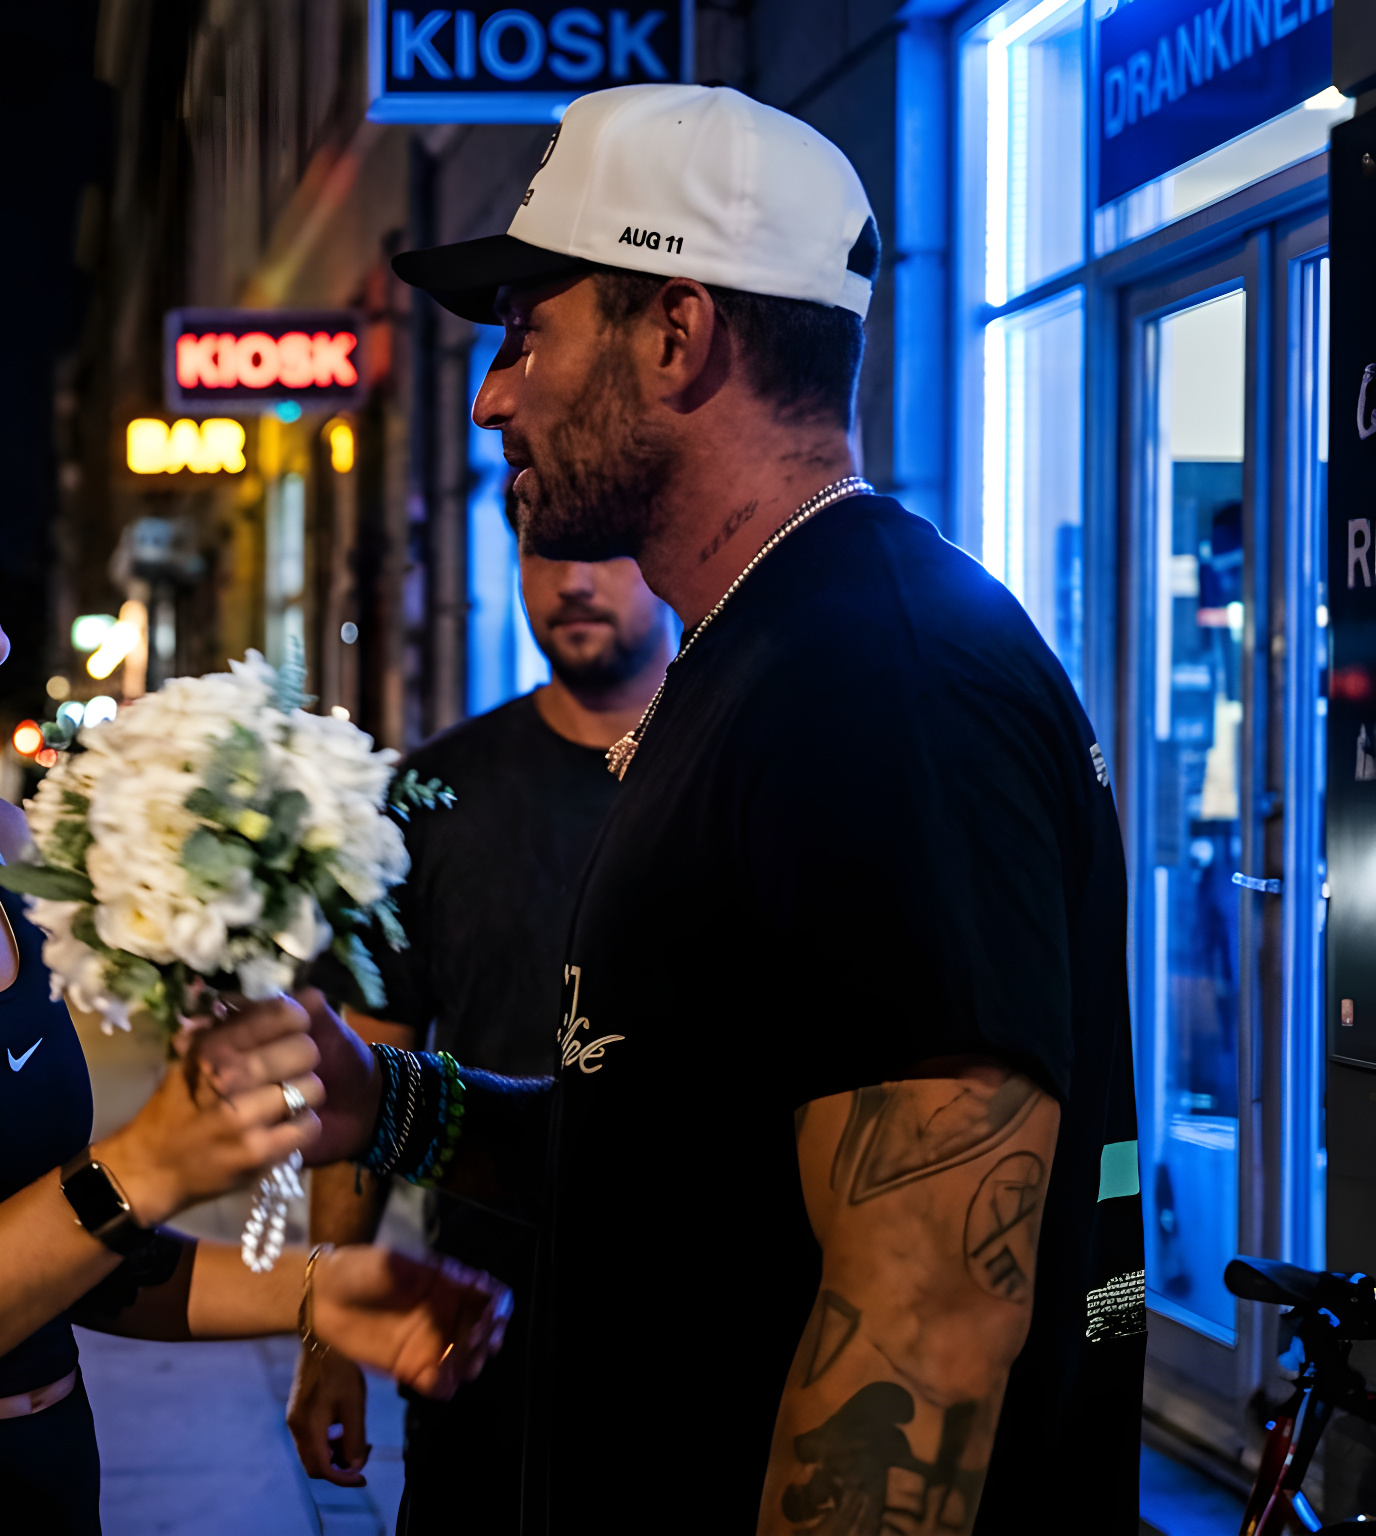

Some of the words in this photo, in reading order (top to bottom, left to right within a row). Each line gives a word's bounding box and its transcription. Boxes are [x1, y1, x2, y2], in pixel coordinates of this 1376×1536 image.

[392, 8, 669, 82] KIOSK
[618, 226, 661, 250] AUG
[665, 235, 684, 254] 11
[175, 331, 359, 389] KIOSK
[127, 418, 247, 474] BAR
